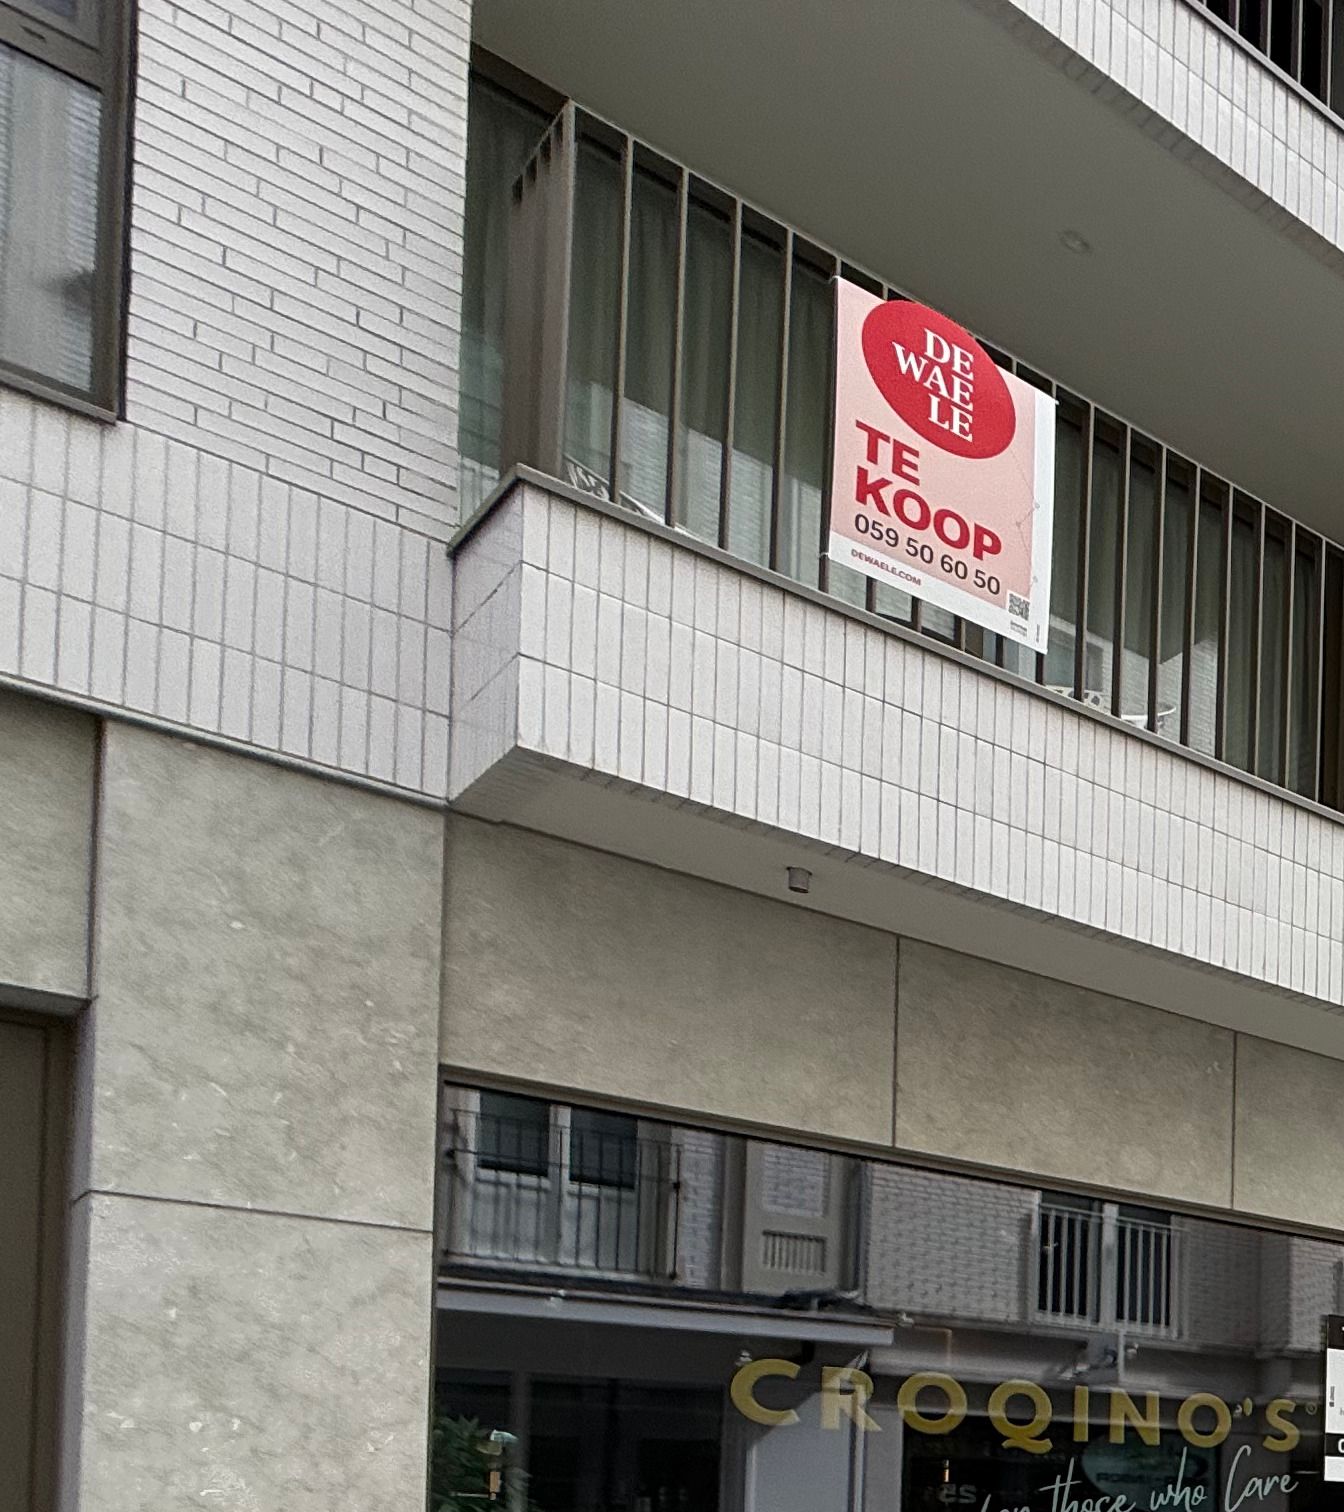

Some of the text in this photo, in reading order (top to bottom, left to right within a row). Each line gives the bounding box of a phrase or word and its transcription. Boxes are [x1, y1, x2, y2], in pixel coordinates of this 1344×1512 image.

[892, 341, 974, 412] WAE
[924, 327, 974, 381] DE
[855, 419, 920, 486] TE
[928, 393, 973, 443] LE
[855, 465, 1003, 562] KOOP
[850, 547, 922, 587] DEWAELE.COM
[854, 512, 1001, 597] 059 50 60 50
[729, 1357, 1300, 1456] CROQINO'S
